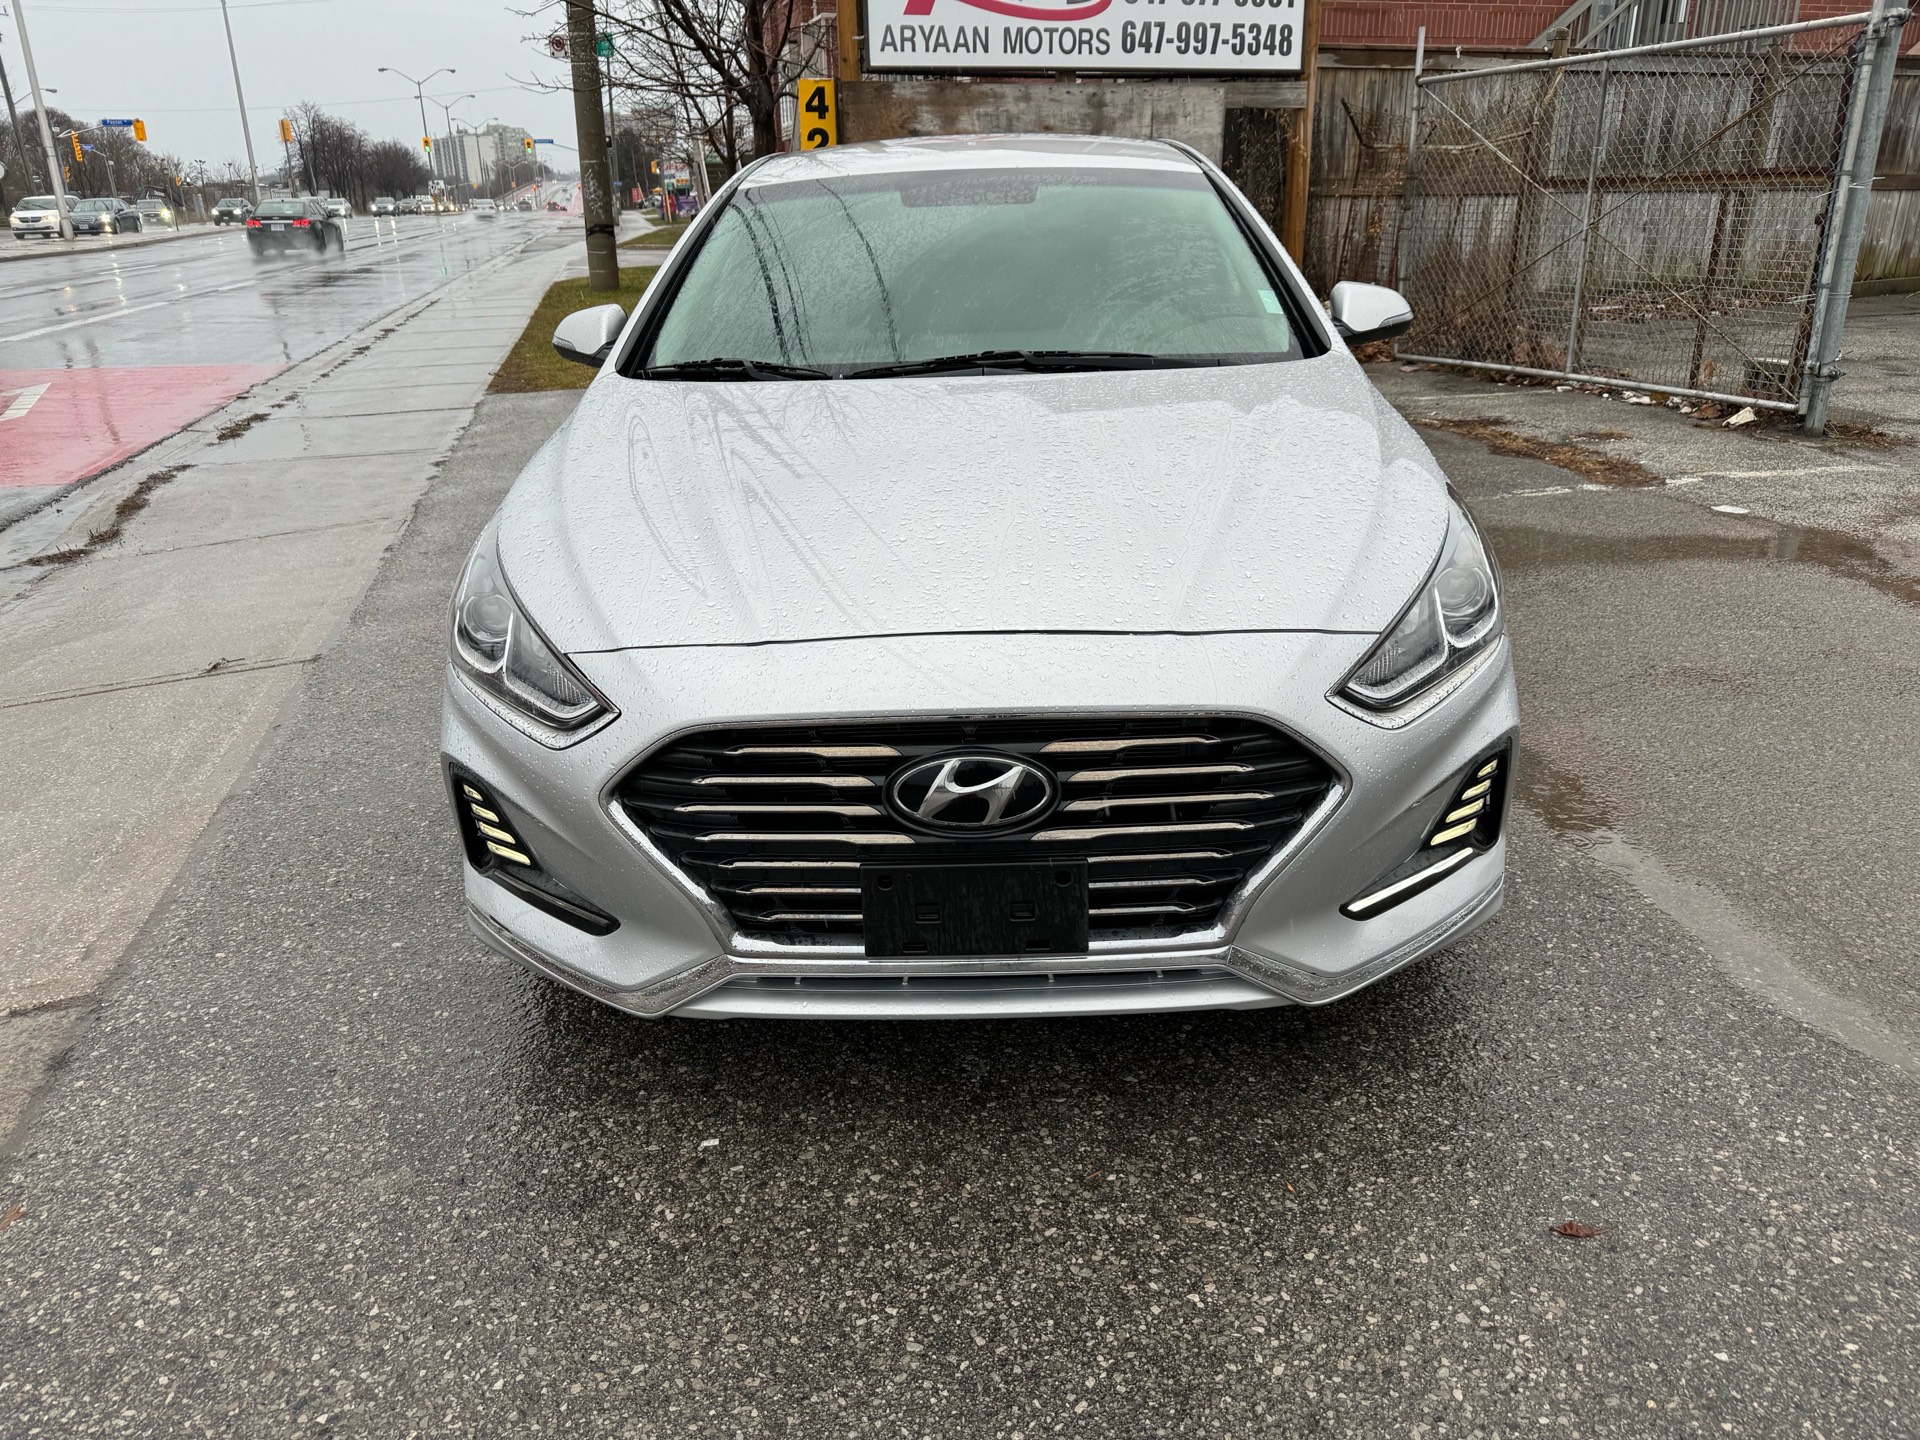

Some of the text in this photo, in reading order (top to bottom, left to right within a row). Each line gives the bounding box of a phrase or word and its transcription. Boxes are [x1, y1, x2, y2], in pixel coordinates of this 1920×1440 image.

[880, 20, 1293, 57] ARYAAN MOTORS 647-997-5348
